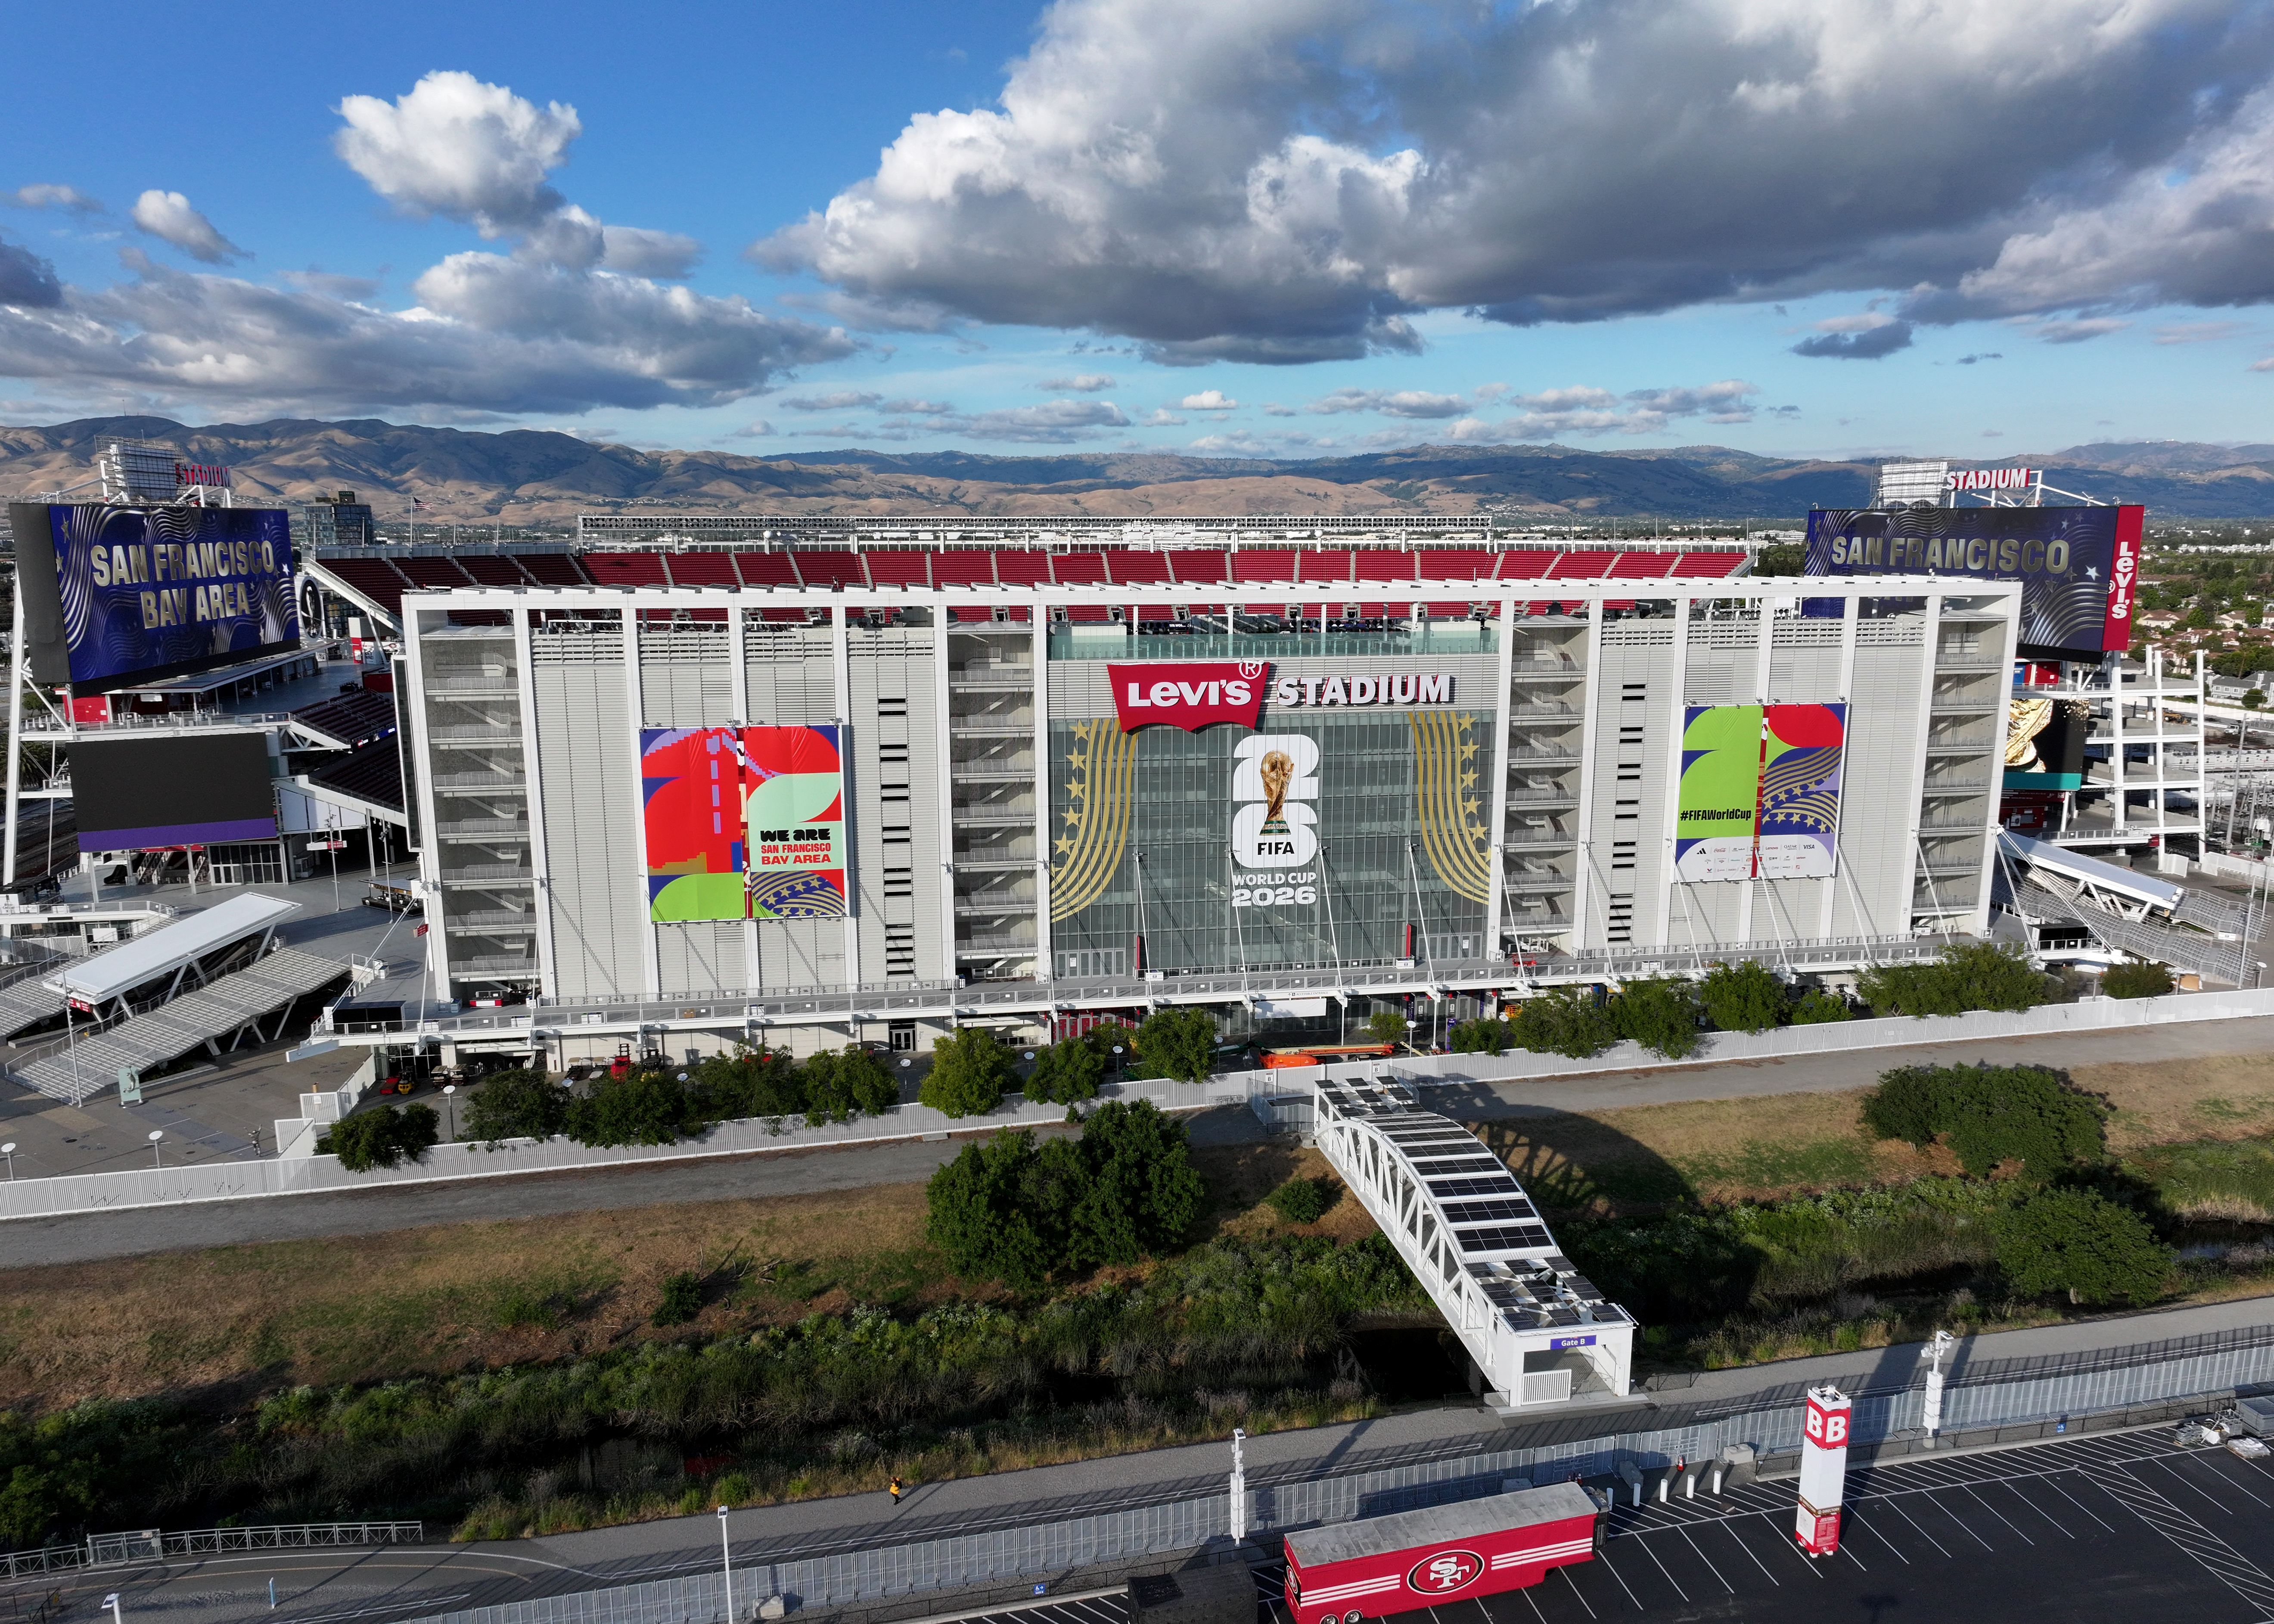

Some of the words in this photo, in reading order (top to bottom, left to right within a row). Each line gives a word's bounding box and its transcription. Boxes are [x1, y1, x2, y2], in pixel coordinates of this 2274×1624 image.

[175, 464, 232, 487] STADIUM
[1946, 469, 2030, 490] STADIUM
[91, 545, 149, 586] SAN
[153, 540, 274, 581] FRANCISCO
[1832, 537, 1883, 565] SAN
[1889, 538, 2069, 573] FRANCISCO
[140, 588, 187, 629] BAY
[196, 582, 250, 622] AREA
[1277, 674, 1451, 705] STADIUM
[1680, 809, 1752, 821] #FIFAWorldCup
[760, 830, 789, 842] WE
[793, 829, 831, 841] ARE
[761, 845, 779, 854] SAN
[782, 843, 831, 853] FRANCISCO
[1258, 841, 1295, 855] FIFA
[761, 855, 789, 865] BAY
[793, 854, 831, 864] AREA
[1233, 873, 1285, 885] WORLD
[1288, 872, 1317, 884] CUP
[1232, 886, 1317, 907] 2026
[1807, 1406, 1822, 1438] B
[1826, 1416, 1845, 1443] B
